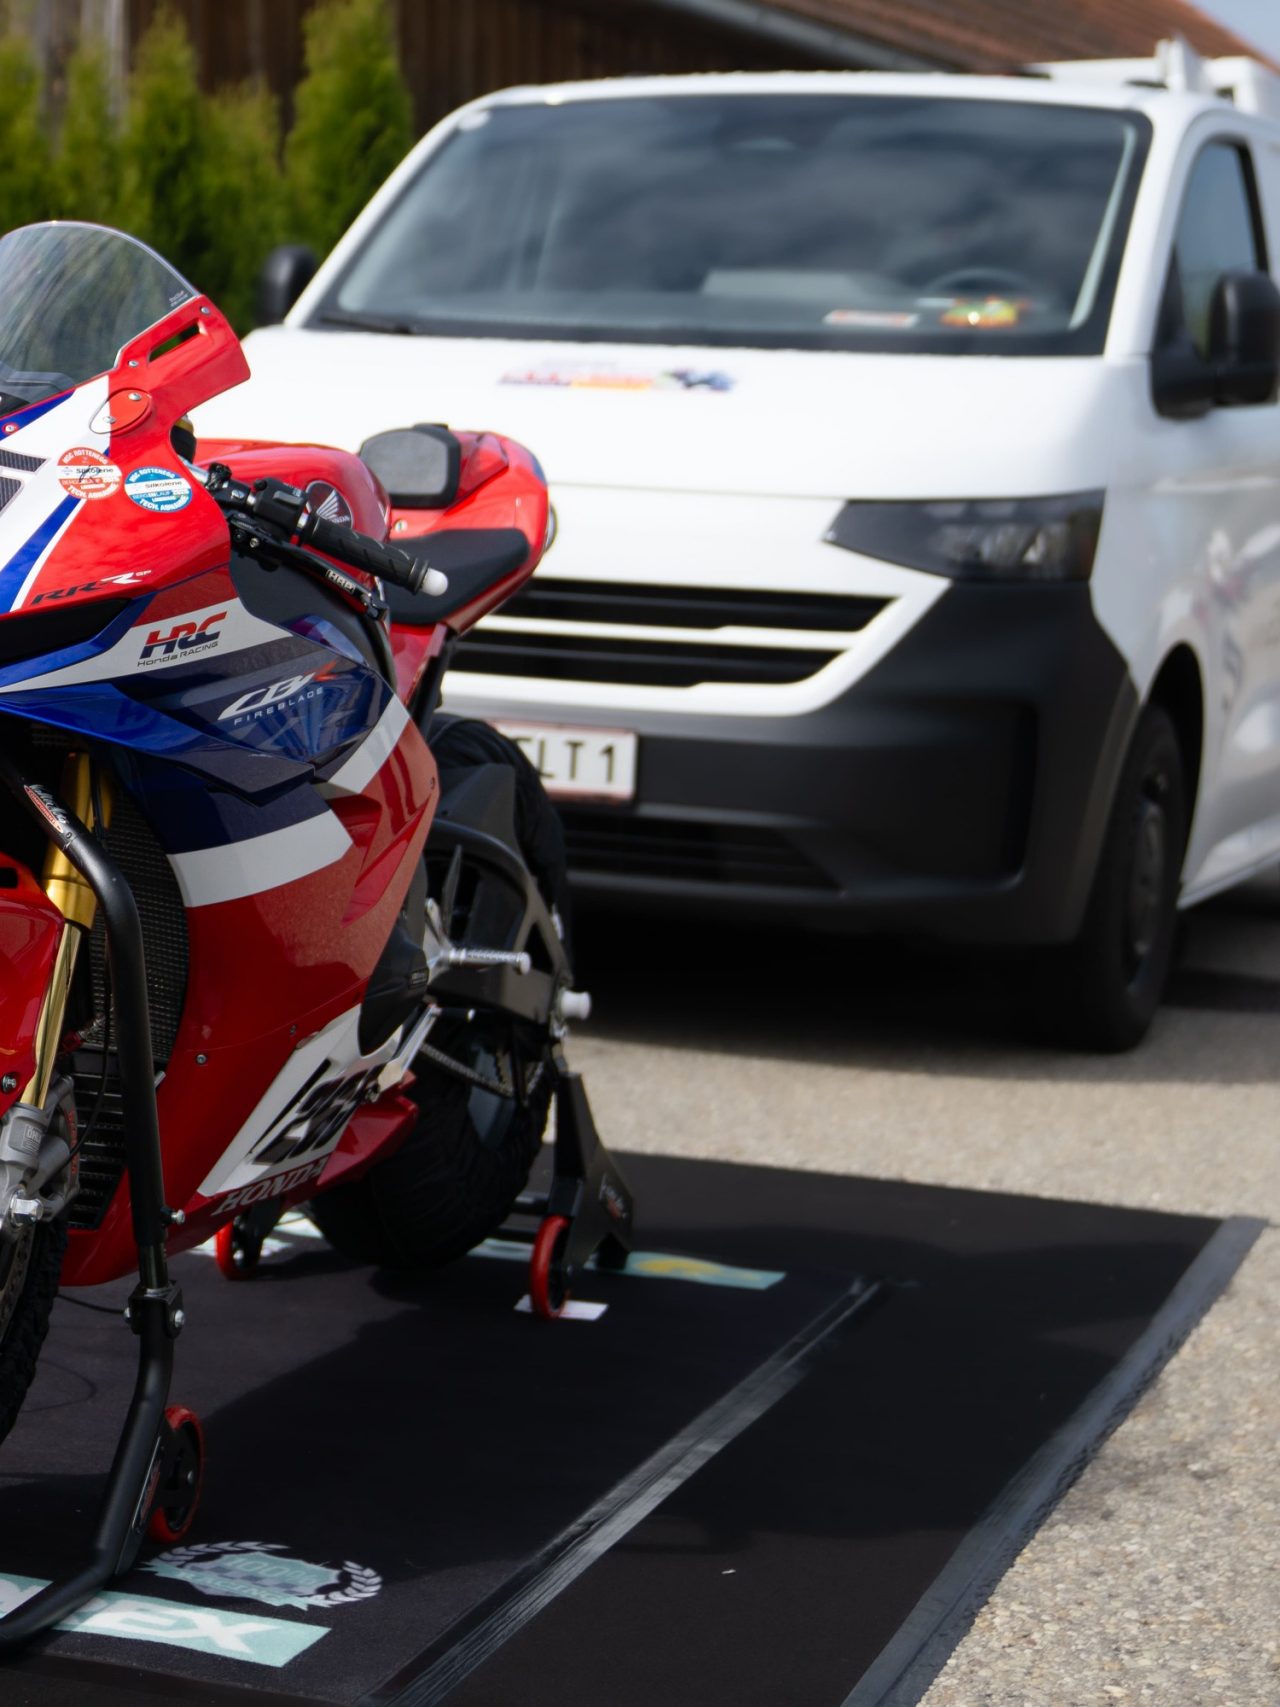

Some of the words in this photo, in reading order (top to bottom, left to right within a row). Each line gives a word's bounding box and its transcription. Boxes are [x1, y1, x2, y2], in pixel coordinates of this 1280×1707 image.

[137, 653, 178, 668] Honda
[179, 641, 219, 658] RACING
[139, 611, 228, 660] HRC
[233, 686, 324, 726] FIREBLADE
[600, 744, 615, 783] 1
[210, 1154, 332, 1216] HONDA
